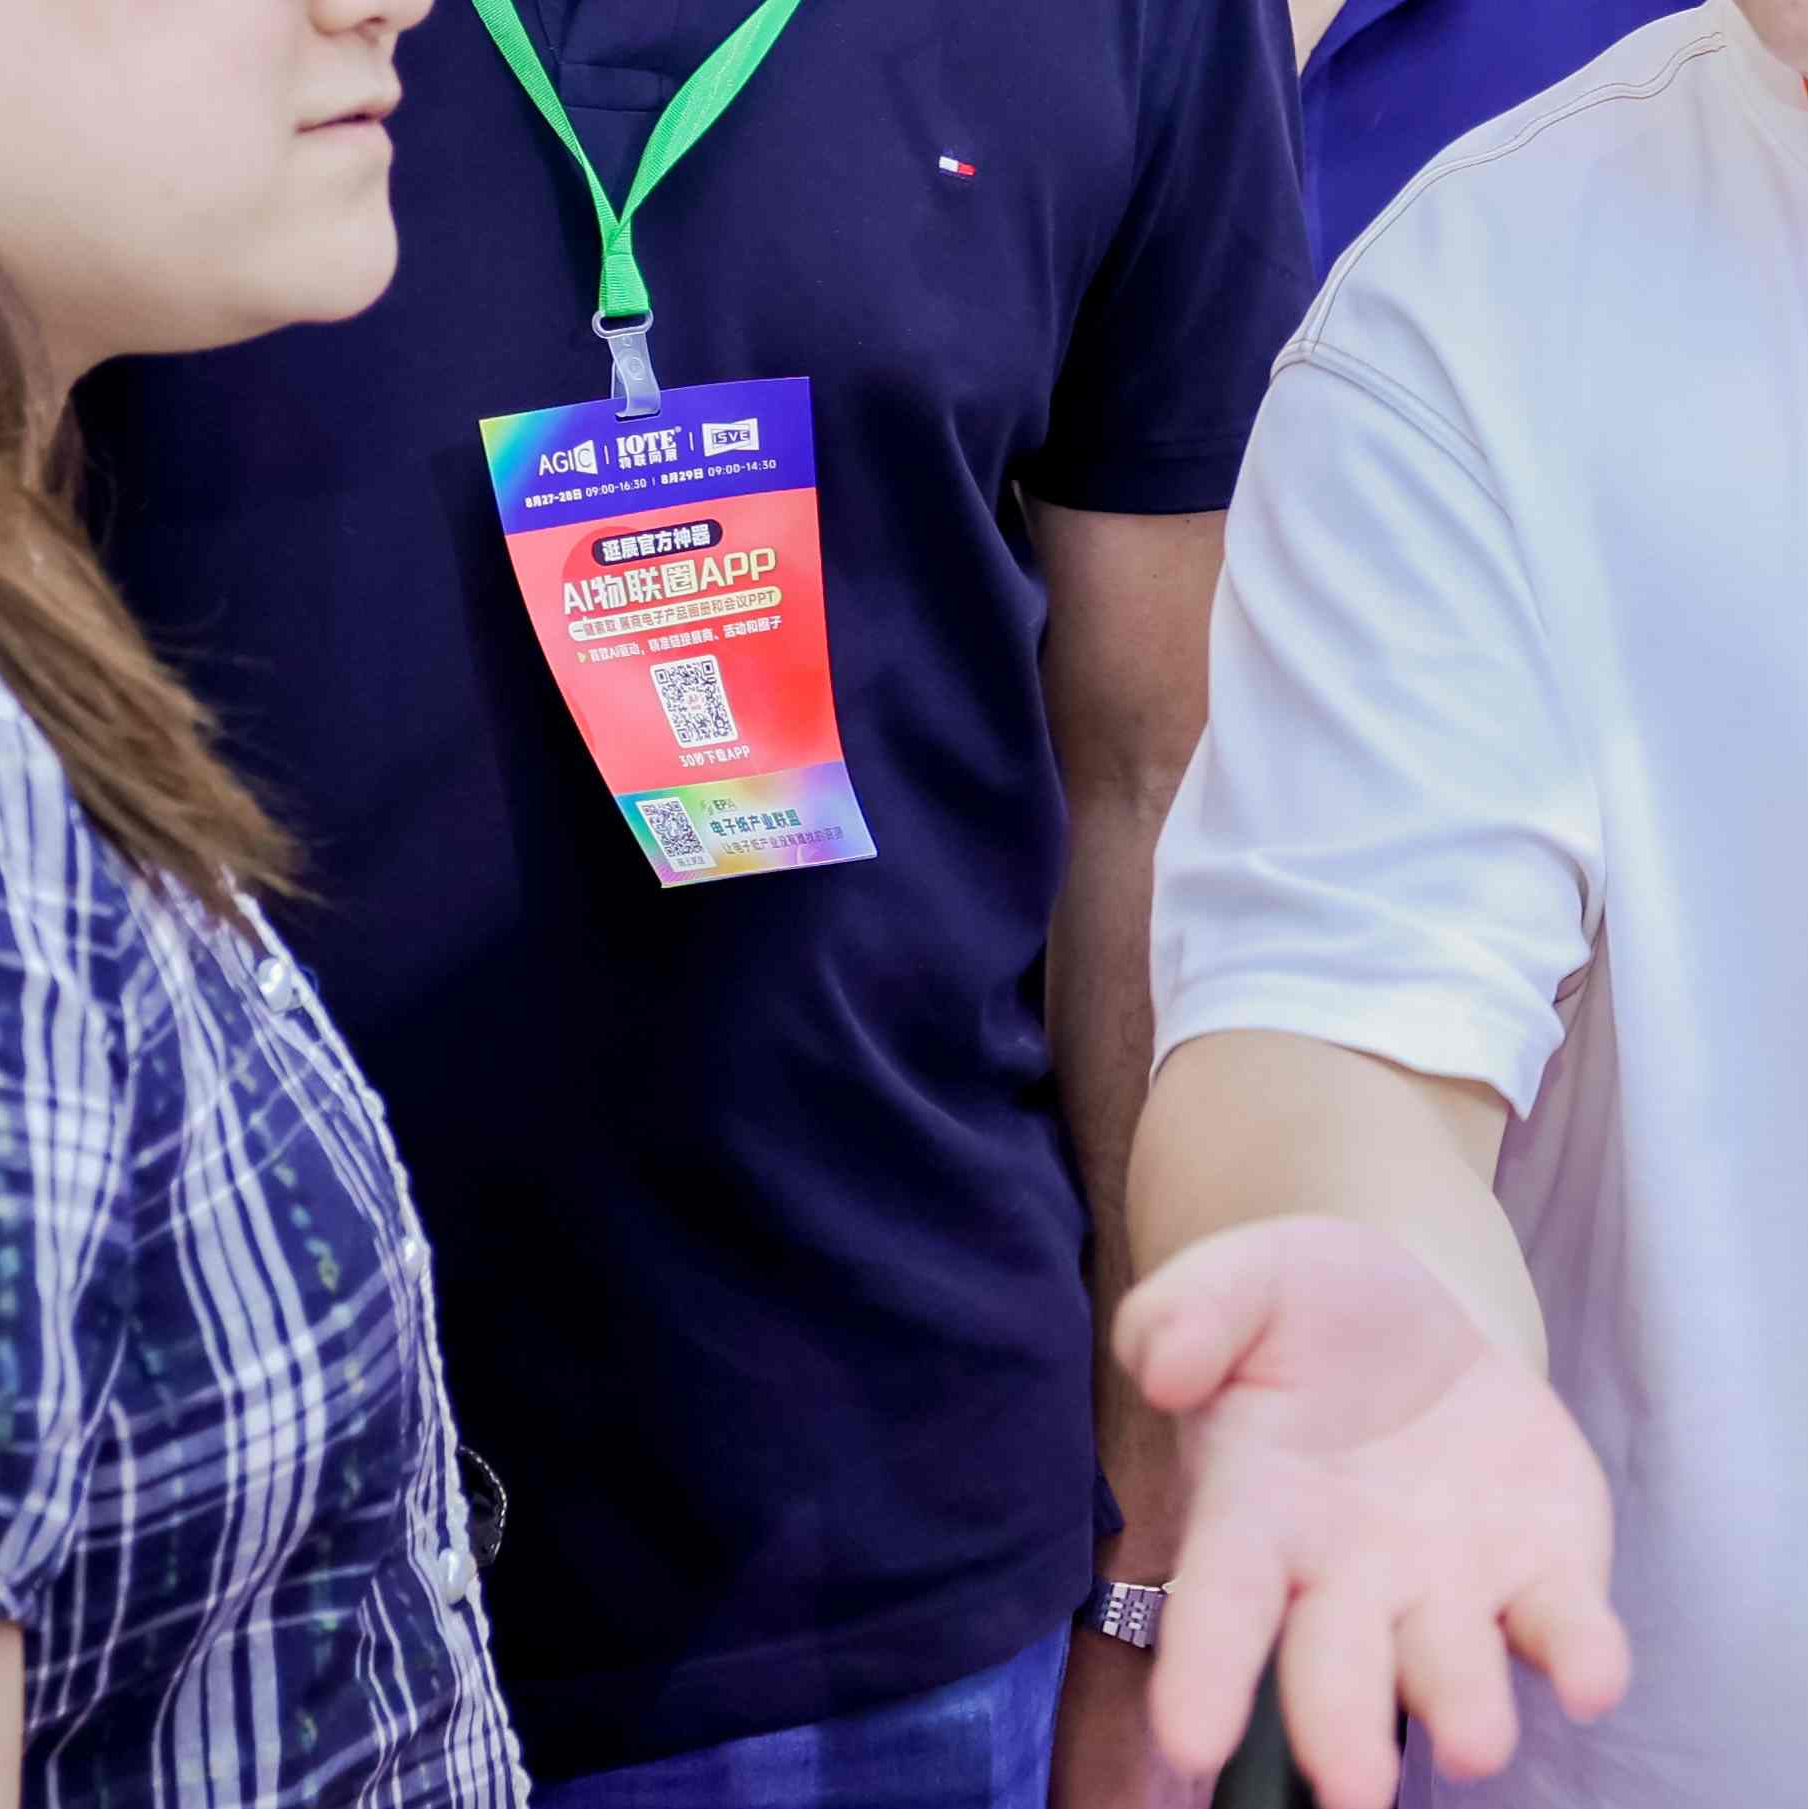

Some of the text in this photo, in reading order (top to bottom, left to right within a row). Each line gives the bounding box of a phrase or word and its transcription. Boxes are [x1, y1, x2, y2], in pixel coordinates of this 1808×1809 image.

[713, 431, 751, 443] ISVE
[539, 440, 598, 476] AGIC
[602, 523, 711, 563] 逛展官方神器
[562, 547, 777, 615] AI物联圈APP
